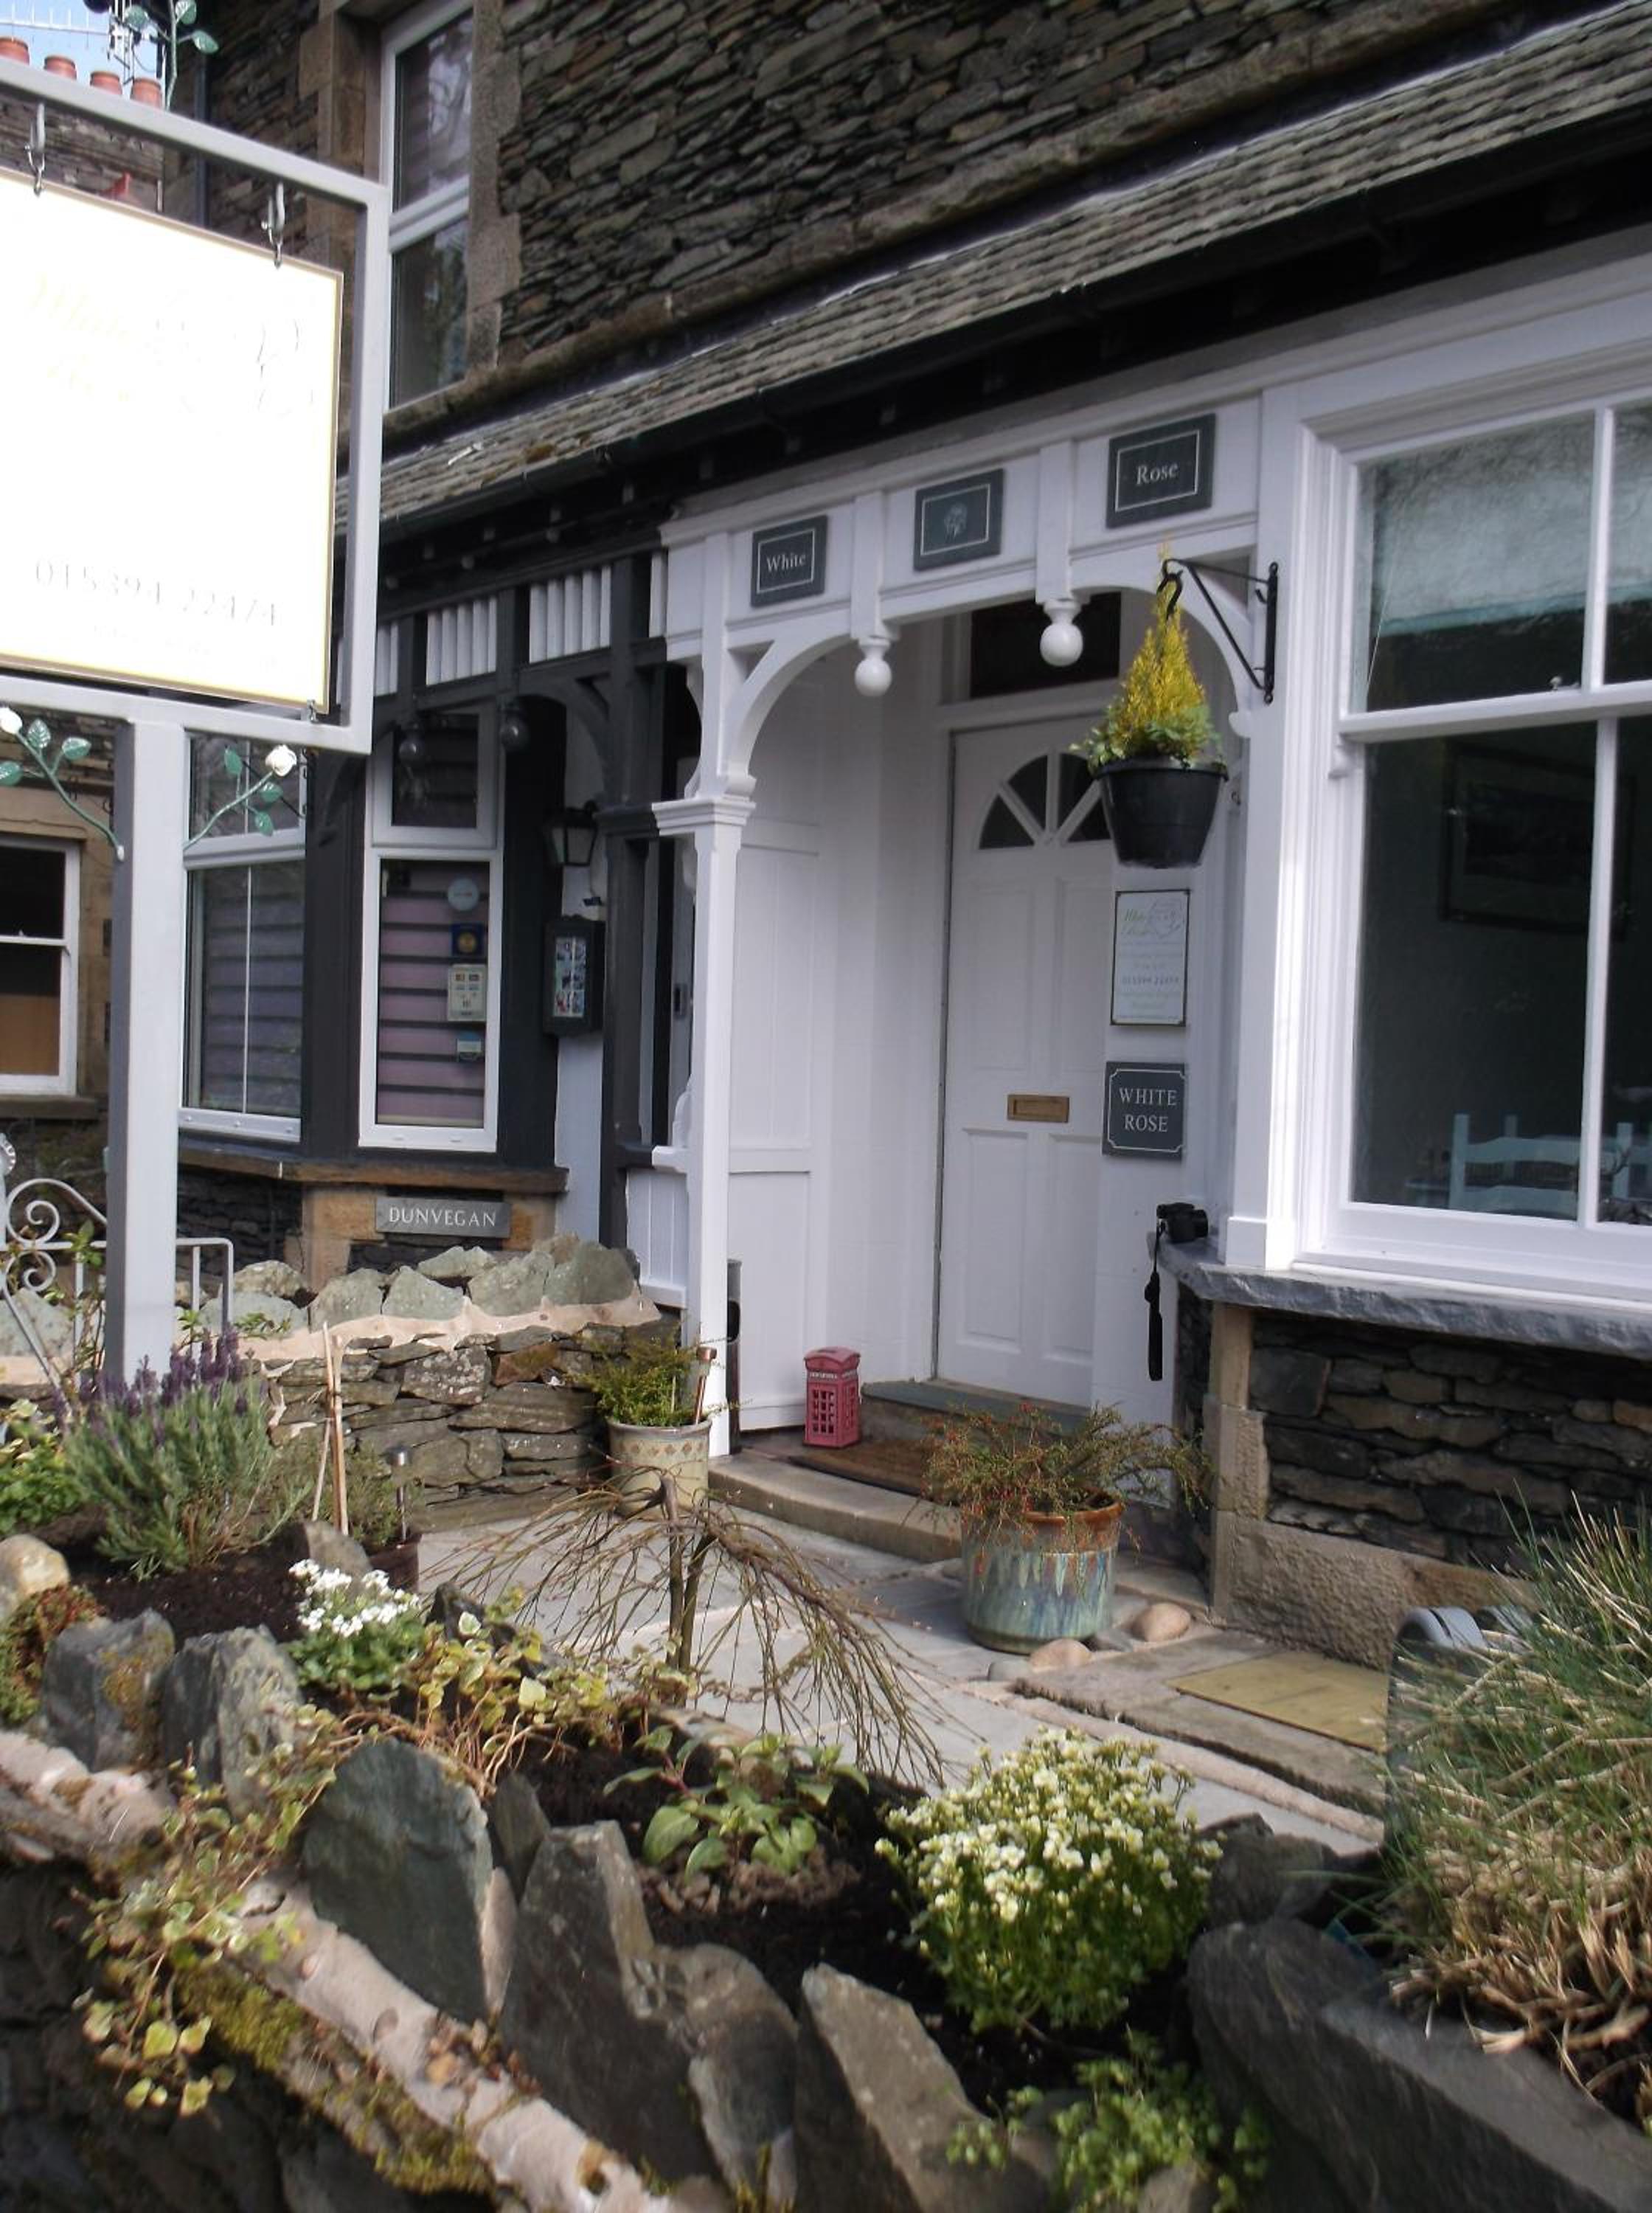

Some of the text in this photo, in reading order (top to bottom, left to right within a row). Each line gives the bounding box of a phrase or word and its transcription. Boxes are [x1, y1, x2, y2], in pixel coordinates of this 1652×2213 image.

[1136, 460, 1179, 485] Rose
[766, 552, 807, 573] White
[1118, 1087, 1178, 1106] WHITE
[1124, 1114, 1169, 1133] ROSE
[388, 1205, 497, 1227] DUNVEGAN
